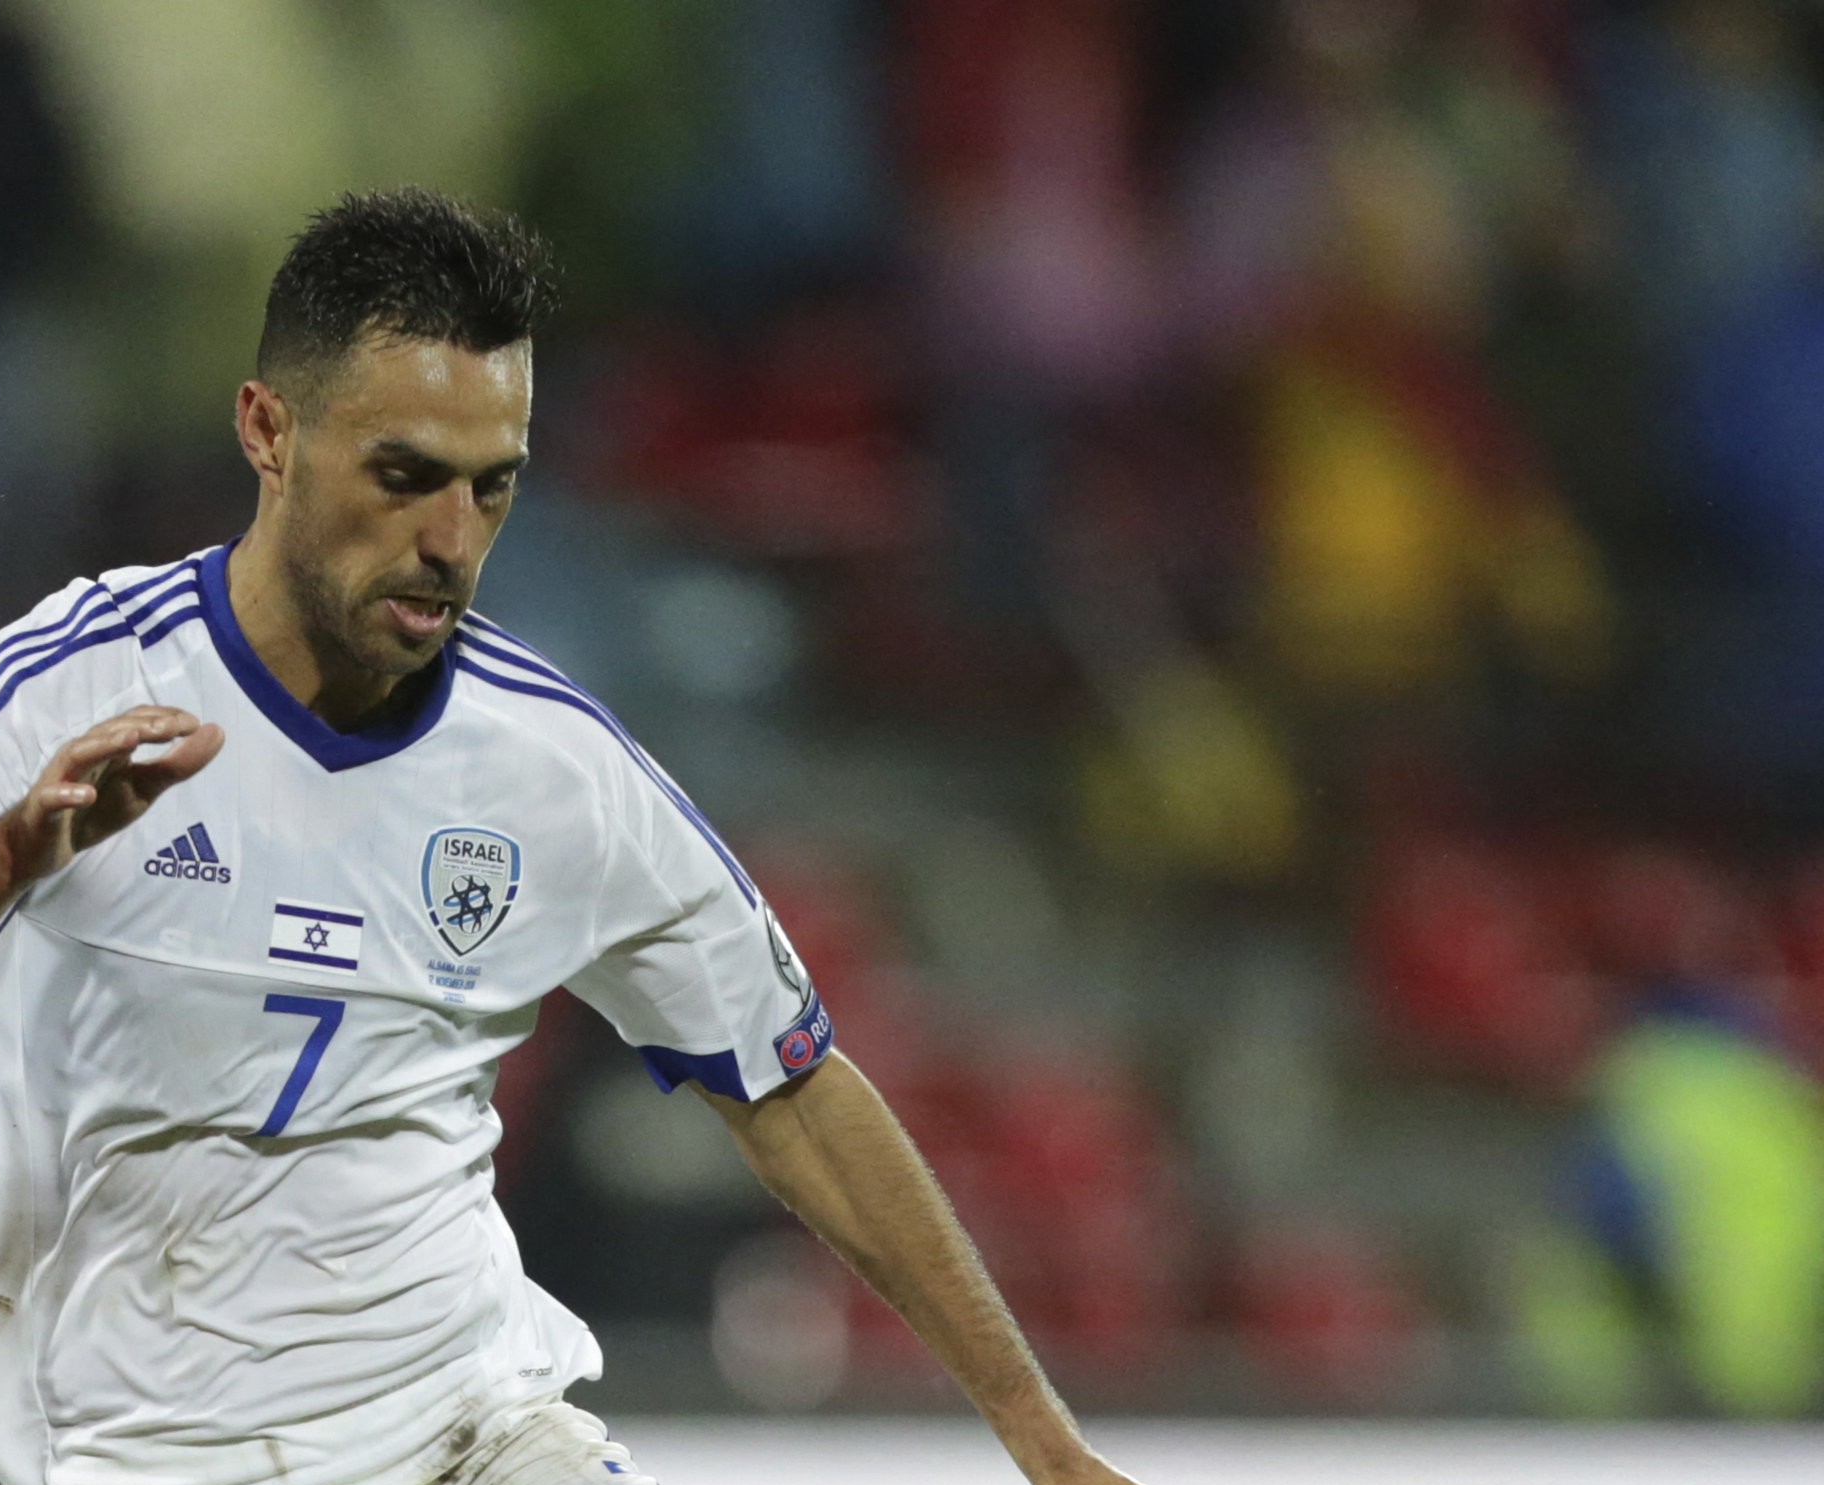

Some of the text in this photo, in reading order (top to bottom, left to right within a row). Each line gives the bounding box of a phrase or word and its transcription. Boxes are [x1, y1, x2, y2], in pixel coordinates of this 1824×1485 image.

[444, 837, 506, 864] ISRAEL
[143, 856, 232, 884] adidas
[263, 993, 346, 1138] 7
